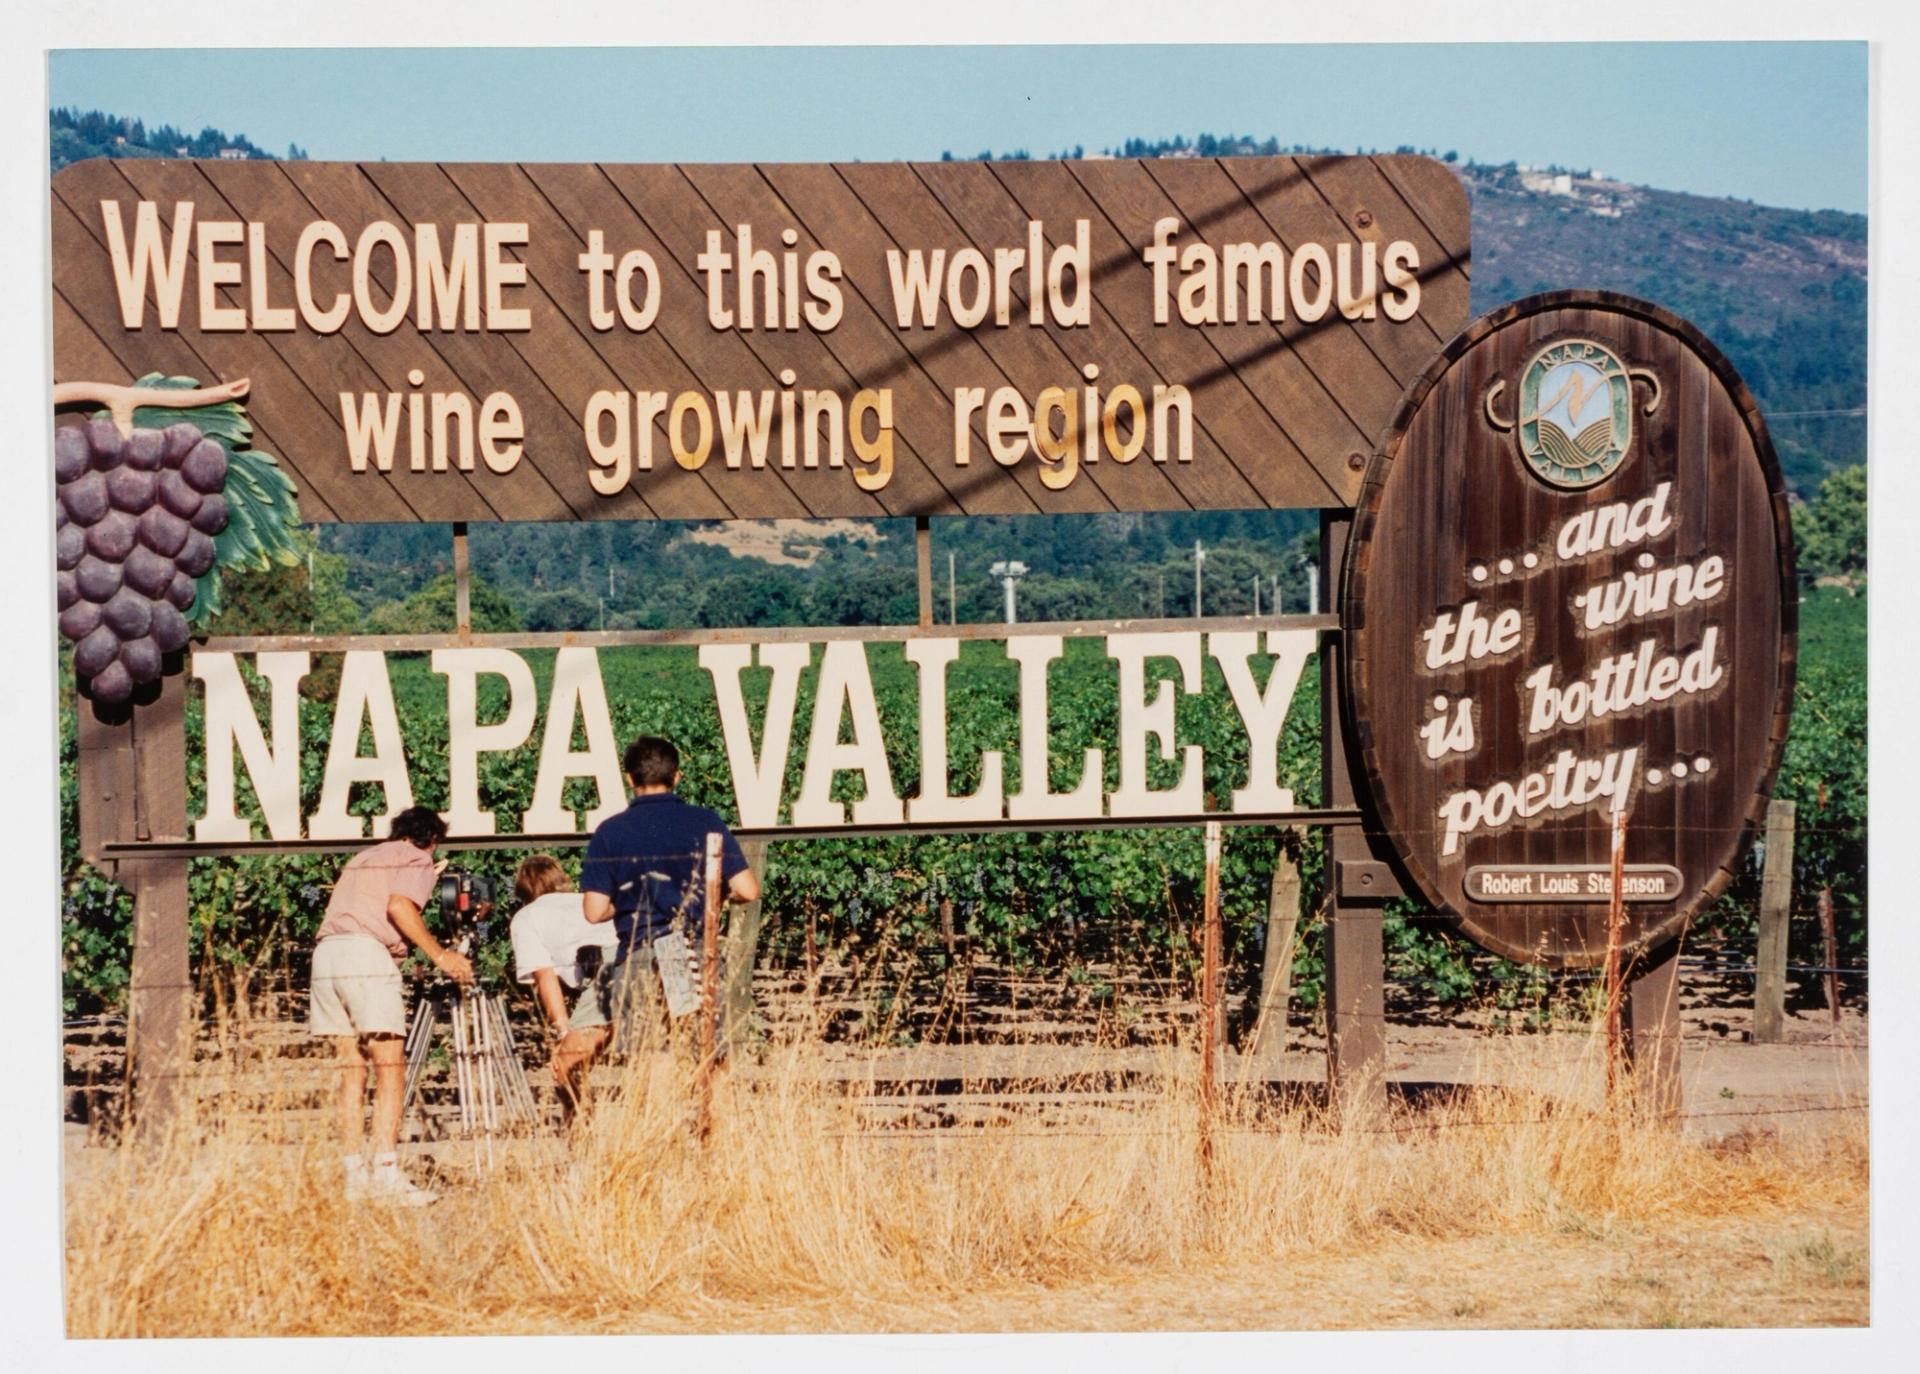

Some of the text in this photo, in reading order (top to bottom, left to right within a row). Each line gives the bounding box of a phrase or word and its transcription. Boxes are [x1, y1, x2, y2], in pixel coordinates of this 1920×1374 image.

[100, 200, 1422, 334] WELCOME to this world famous
[1538, 343, 1609, 372] NAPA
[339, 363, 1194, 495] wine growing region
[1423, 553, 1724, 669] the wine
[192, 630, 1317, 842] NAPA VALLEY
[1420, 626, 1722, 759] is bottled
[1481, 873, 1665, 894] Robert Louis Steenson
